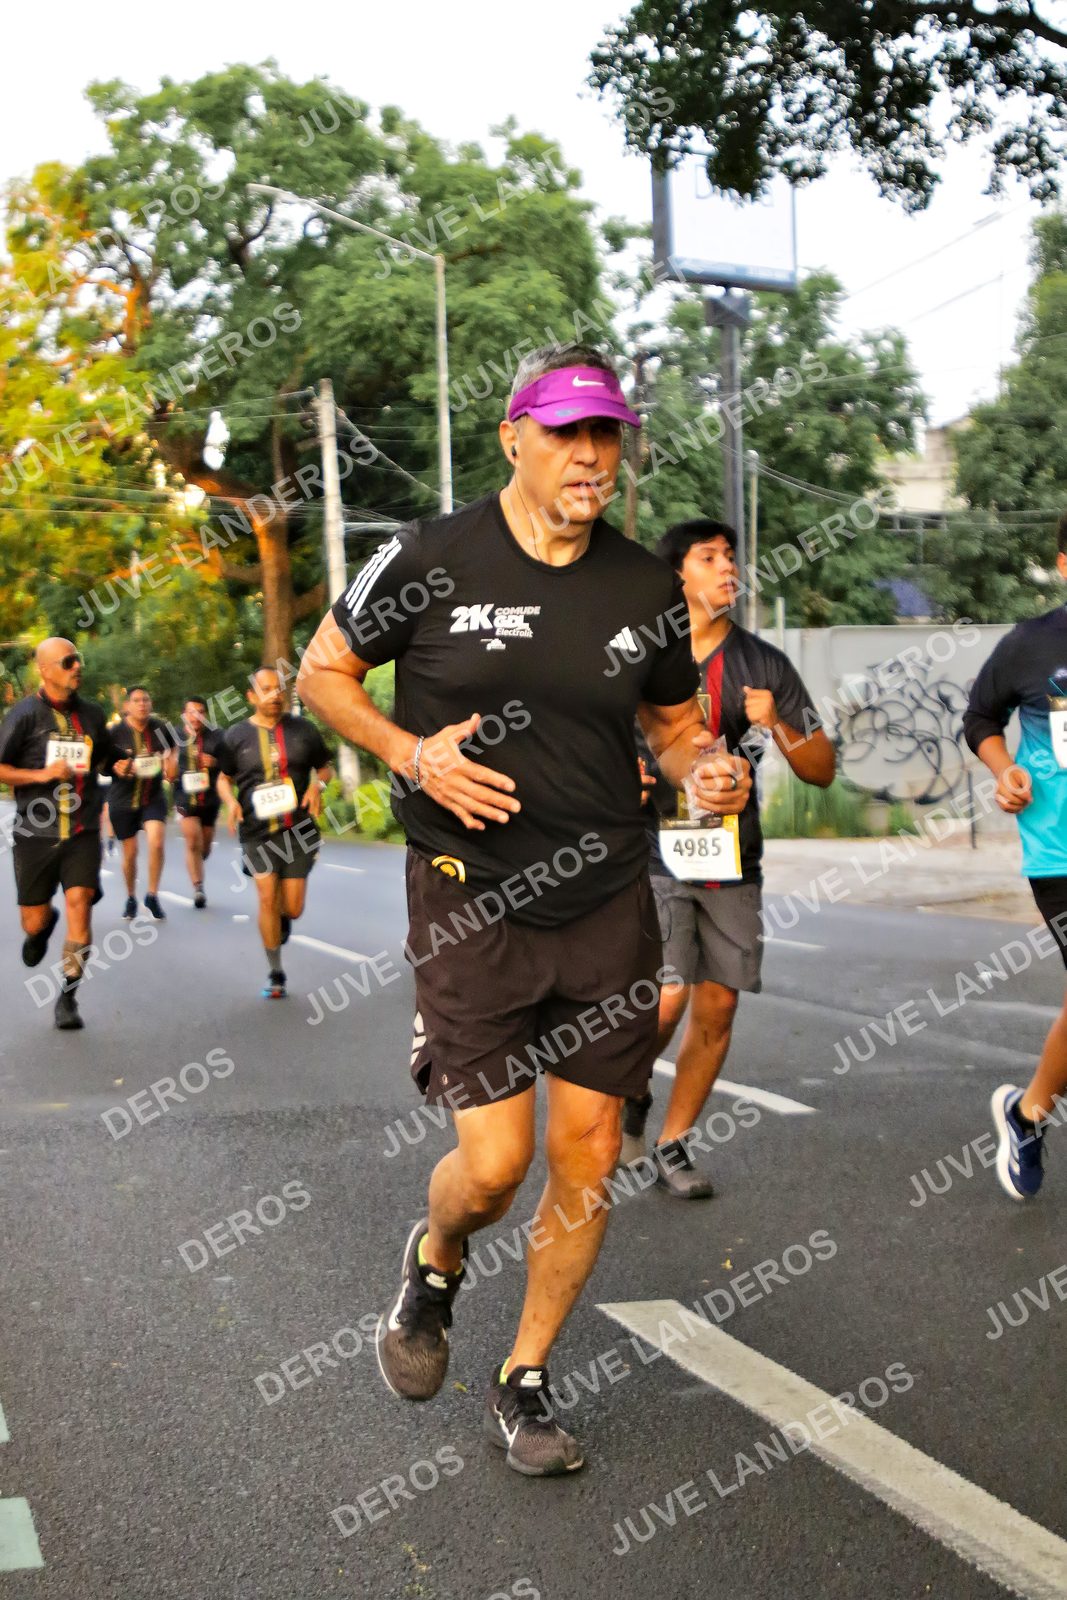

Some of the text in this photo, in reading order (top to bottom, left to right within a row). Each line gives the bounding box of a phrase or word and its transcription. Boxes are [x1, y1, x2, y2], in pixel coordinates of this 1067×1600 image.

[450, 604, 541, 633] 21K COMUDE
[493, 615, 529, 628] GDL
[495, 628, 534, 638] Electrolit
[673, 837, 722, 857] 4985
